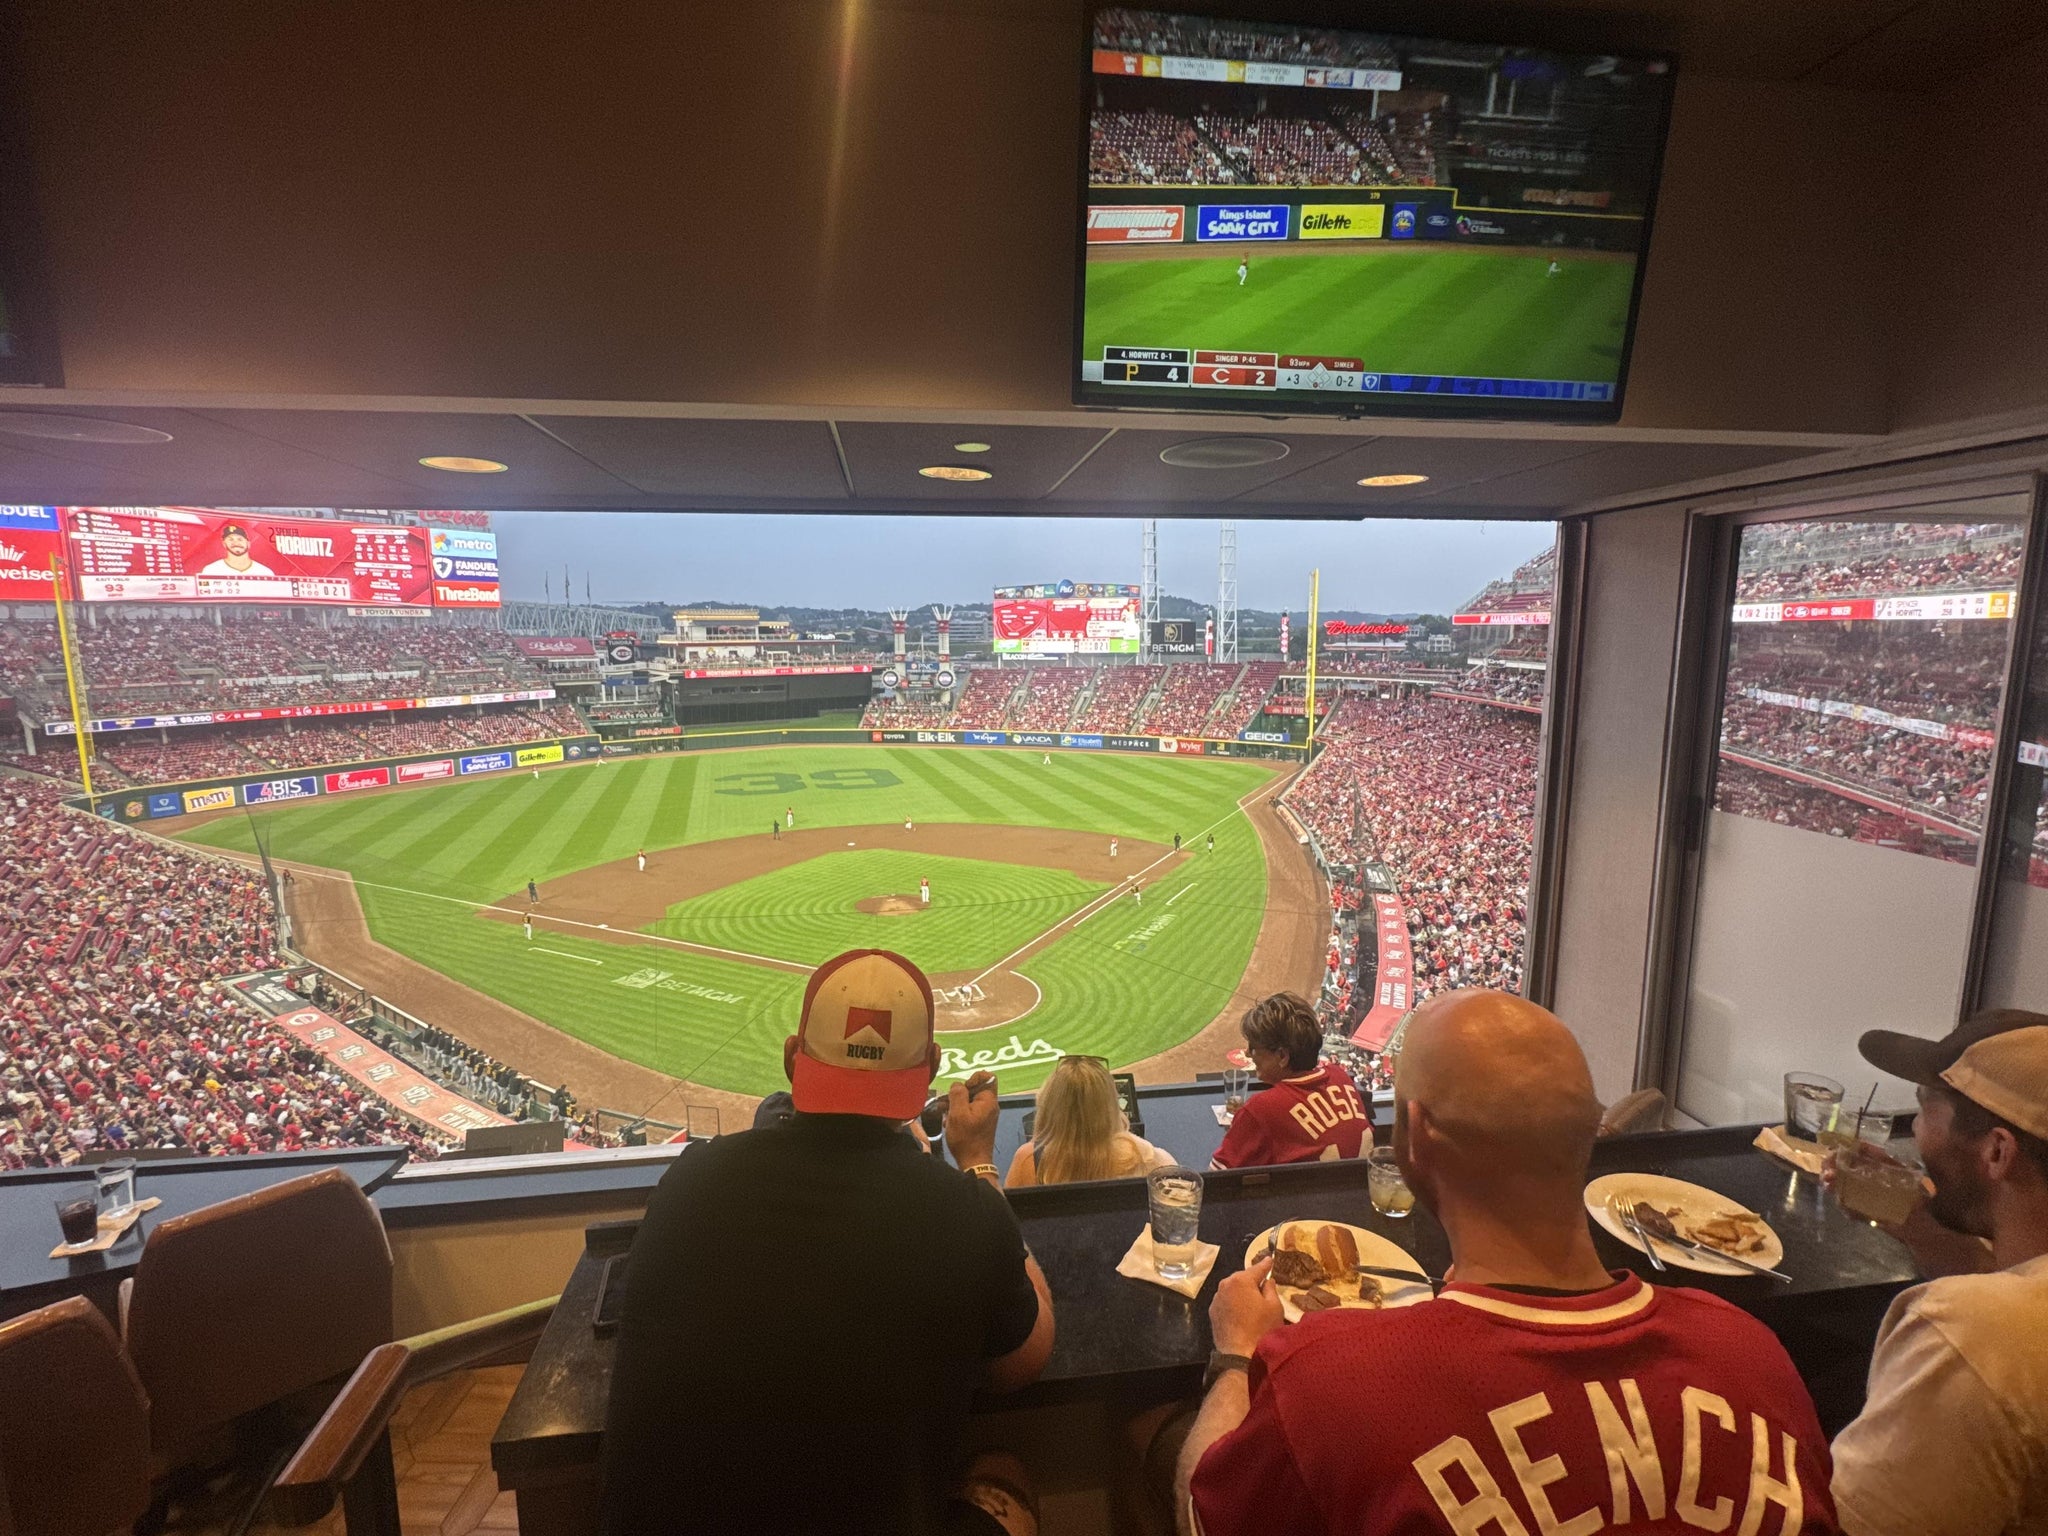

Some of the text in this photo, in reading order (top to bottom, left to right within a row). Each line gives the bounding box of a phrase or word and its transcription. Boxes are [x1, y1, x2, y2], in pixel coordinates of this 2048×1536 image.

[1219, 209, 1272, 220] Kings Island
[1302, 214, 1352, 230] Gillette
[1248, 220, 1279, 236] CITY
[1128, 352, 1159, 360] HORWITZ
[1215, 354, 1238, 364] SINGER
[1126, 363, 1139, 382] P
[1167, 367, 1178, 382] 4
[1256, 371, 1266, 384] 2
[1294, 373, 1300, 384] 3
[1336, 375, 1354, 387] 0-2
[0, 505, 51, 519] DUEL
[275, 527, 299, 536] SPENCER
[275, 536, 334, 558] HORWITZ
[454, 538, 494, 550] metro
[455, 560, 498, 571] FANDUEL
[105, 584, 124, 592] 93
[324, 586, 329, 596] 0
[332, 586, 338, 596] 2
[1060, 585, 1074, 593] P&G
[436, 586, 500, 602] ThreeBond
[1896, 600, 1919, 608] SPENCER
[1896, 609, 1922, 617] HORWITZ
[1324, 620, 1410, 636] Budweiser
[528, 640, 577, 651] Reds
[1152, 644, 1194, 652] BETMGM
[917, 732, 956, 742] Elk Elk
[1022, 736, 1052, 744] VANDA
[1244, 732, 1284, 742] GEICO
[1112, 740, 1150, 748] MEDPACE
[1180, 742, 1202, 752] Wyler
[519, 753, 546, 763] Gillette
[488, 760, 506, 768] CITY
[714, 768, 904, 796] 39
[260, 779, 302, 798] 4BIS
[656, 979, 745, 1004] BETMGM
[847, 1043, 886, 1060] RUGBY
[935, 1036, 1066, 1078] Reds
[1289, 1084, 1366, 1140] ROSE
[1411, 1378, 1804, 1536] BENCH
